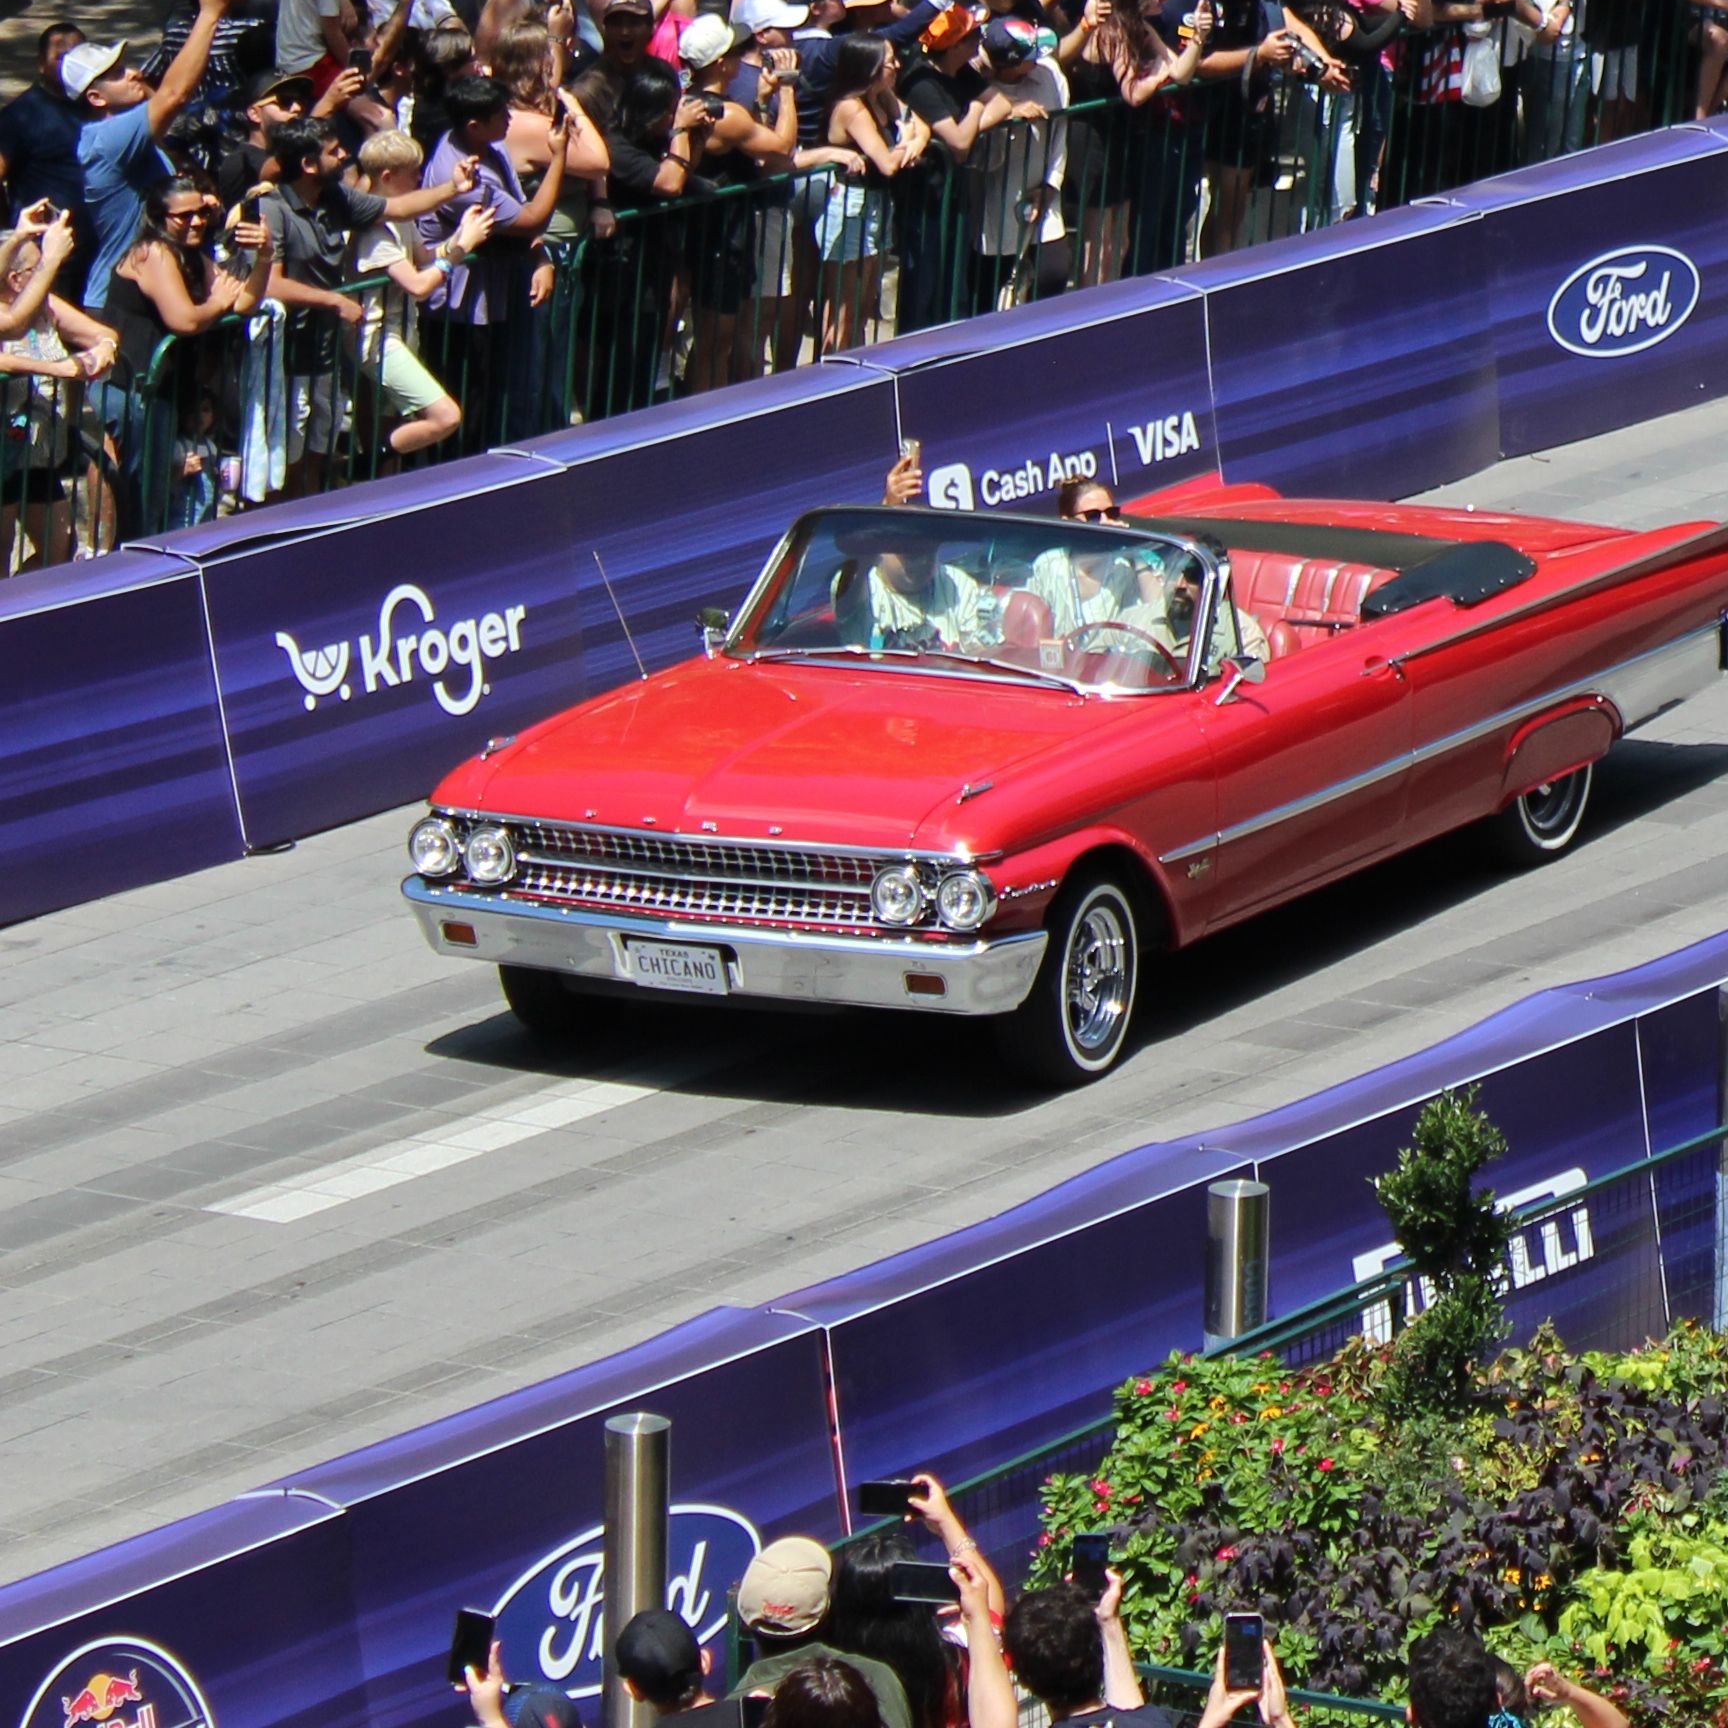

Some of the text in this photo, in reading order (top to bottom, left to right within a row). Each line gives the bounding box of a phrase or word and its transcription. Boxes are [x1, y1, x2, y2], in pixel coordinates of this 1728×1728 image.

[1580, 261, 1671, 343] Ford
[1128, 411, 1199, 465] VISA
[981, 460, 1043, 504] Cash
[360, 583, 525, 716] Kroger
[638, 956, 716, 980] CHICANO
[660, 949, 689, 959] TEXAS
